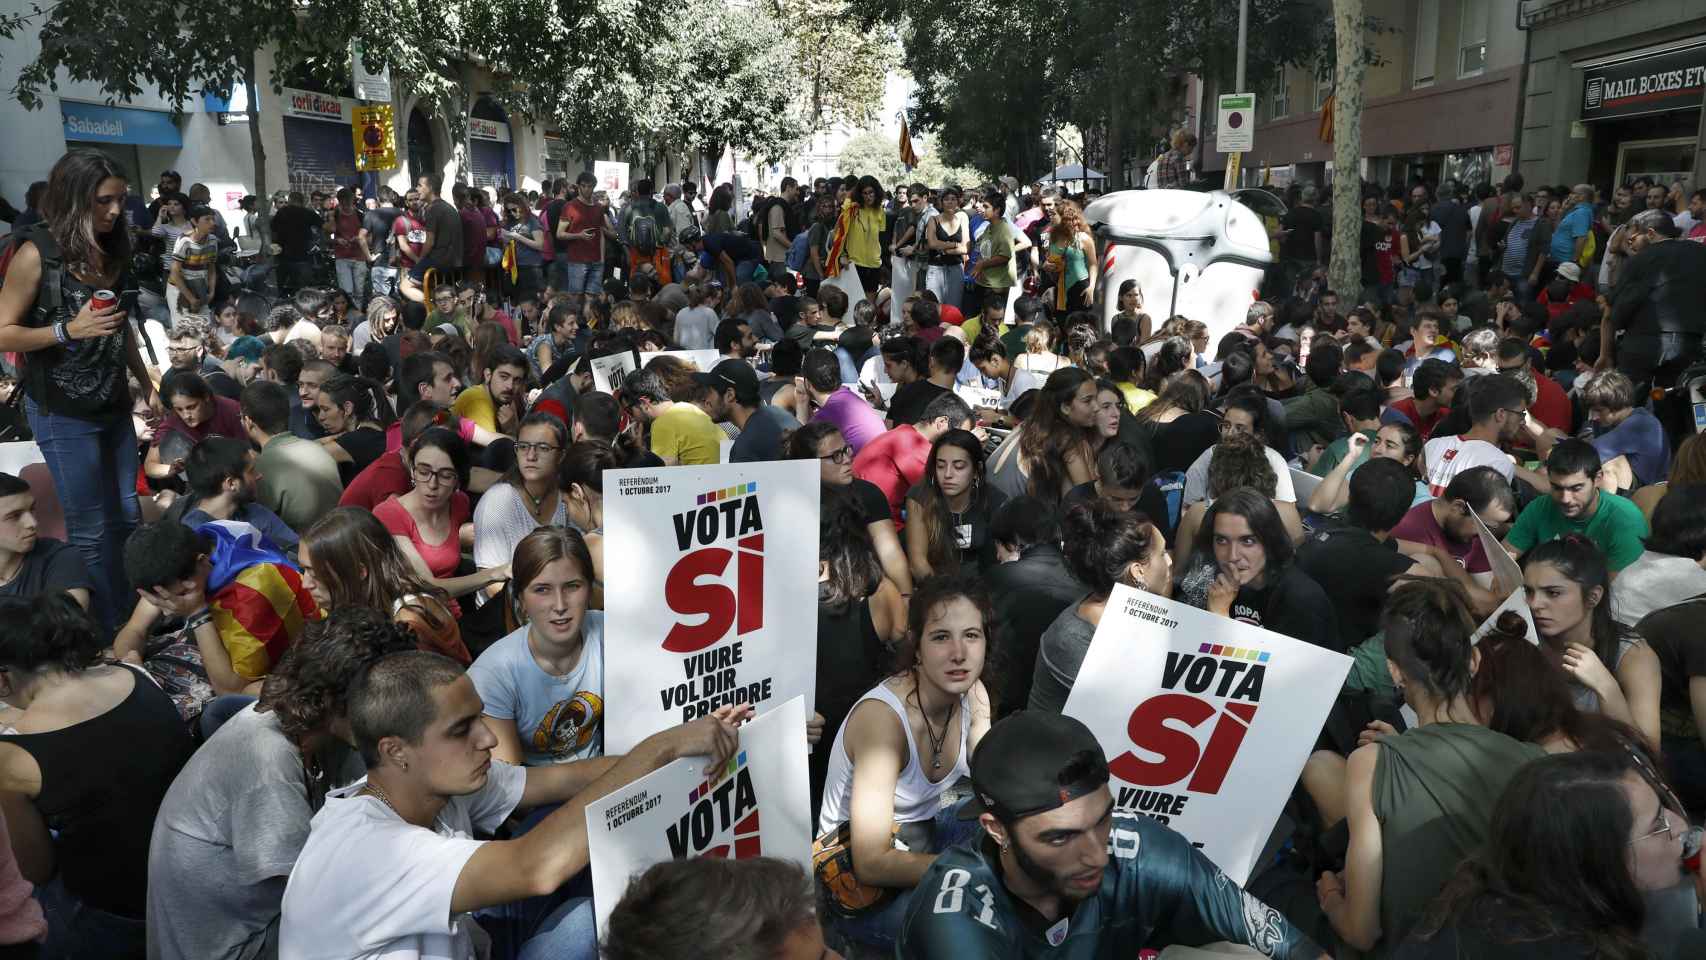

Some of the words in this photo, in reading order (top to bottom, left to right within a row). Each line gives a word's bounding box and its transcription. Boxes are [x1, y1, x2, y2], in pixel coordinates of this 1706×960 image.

[1604, 78, 1638, 100] MAIL
[1639, 69, 1682, 95] BOXES
[68, 115, 124, 137] Sabadell
[619, 488, 623, 496] 1
[624, 486, 654, 496] OCTUBRE
[655, 485, 671, 494] 2017
[672, 494, 764, 552] VOTA
[661, 533, 764, 653] SÍ
[1123, 606, 1128, 614] 1
[1128, 608, 1160, 624] OCTUBRE
[1160, 617, 1178, 629] 2017
[683, 641, 744, 681] VIURE
[1160, 651, 1266, 703] VOTA
[660, 680, 700, 712] VOL
[702, 667, 737, 700] DIR
[1107, 693, 1258, 795] SÍ
[607, 821, 611, 831] 1
[612, 803, 644, 828] OCTUBRE
[644, 794, 662, 811] 2017
[665, 765, 758, 861] VOTA
[1116, 786, 1190, 816] VIURE
[932, 867, 1000, 931] 81
